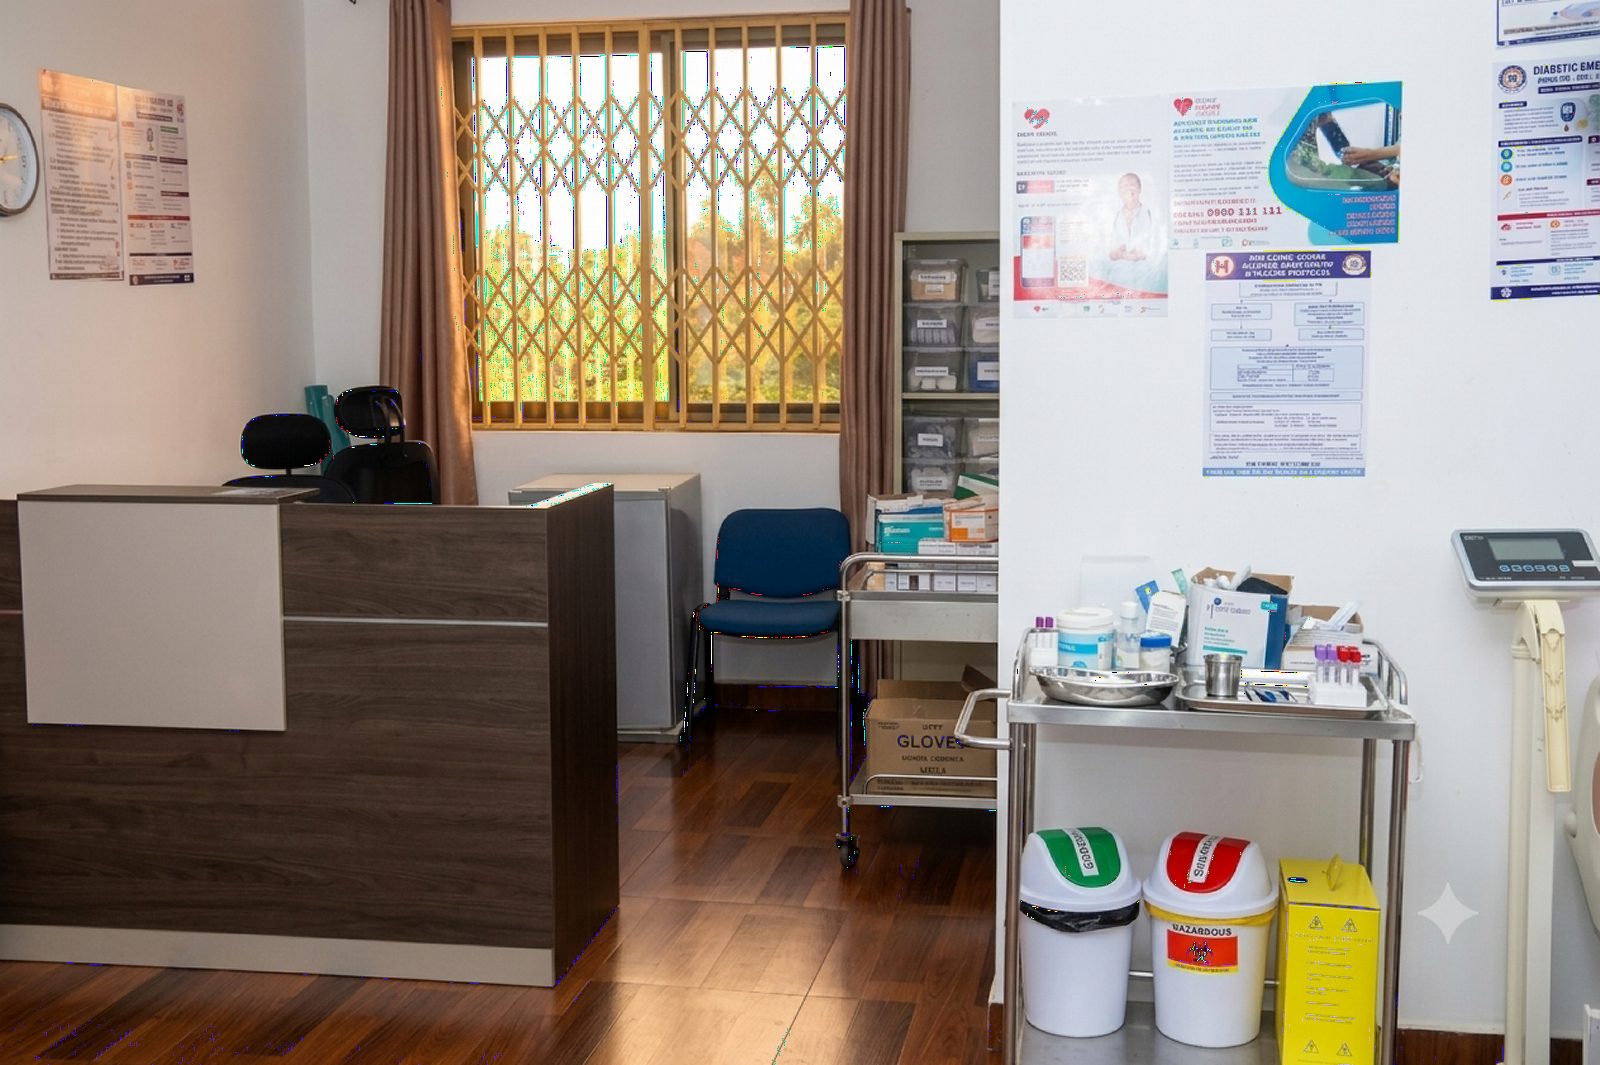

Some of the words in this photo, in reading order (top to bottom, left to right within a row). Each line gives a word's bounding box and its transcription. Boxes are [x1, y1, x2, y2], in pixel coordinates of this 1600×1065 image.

[1533, 63, 1578, 75] DIABETIC
[1239, 207, 1257, 216] 111
[1263, 206, 1282, 215] 111
[897, 734, 965, 749] GLOVES
